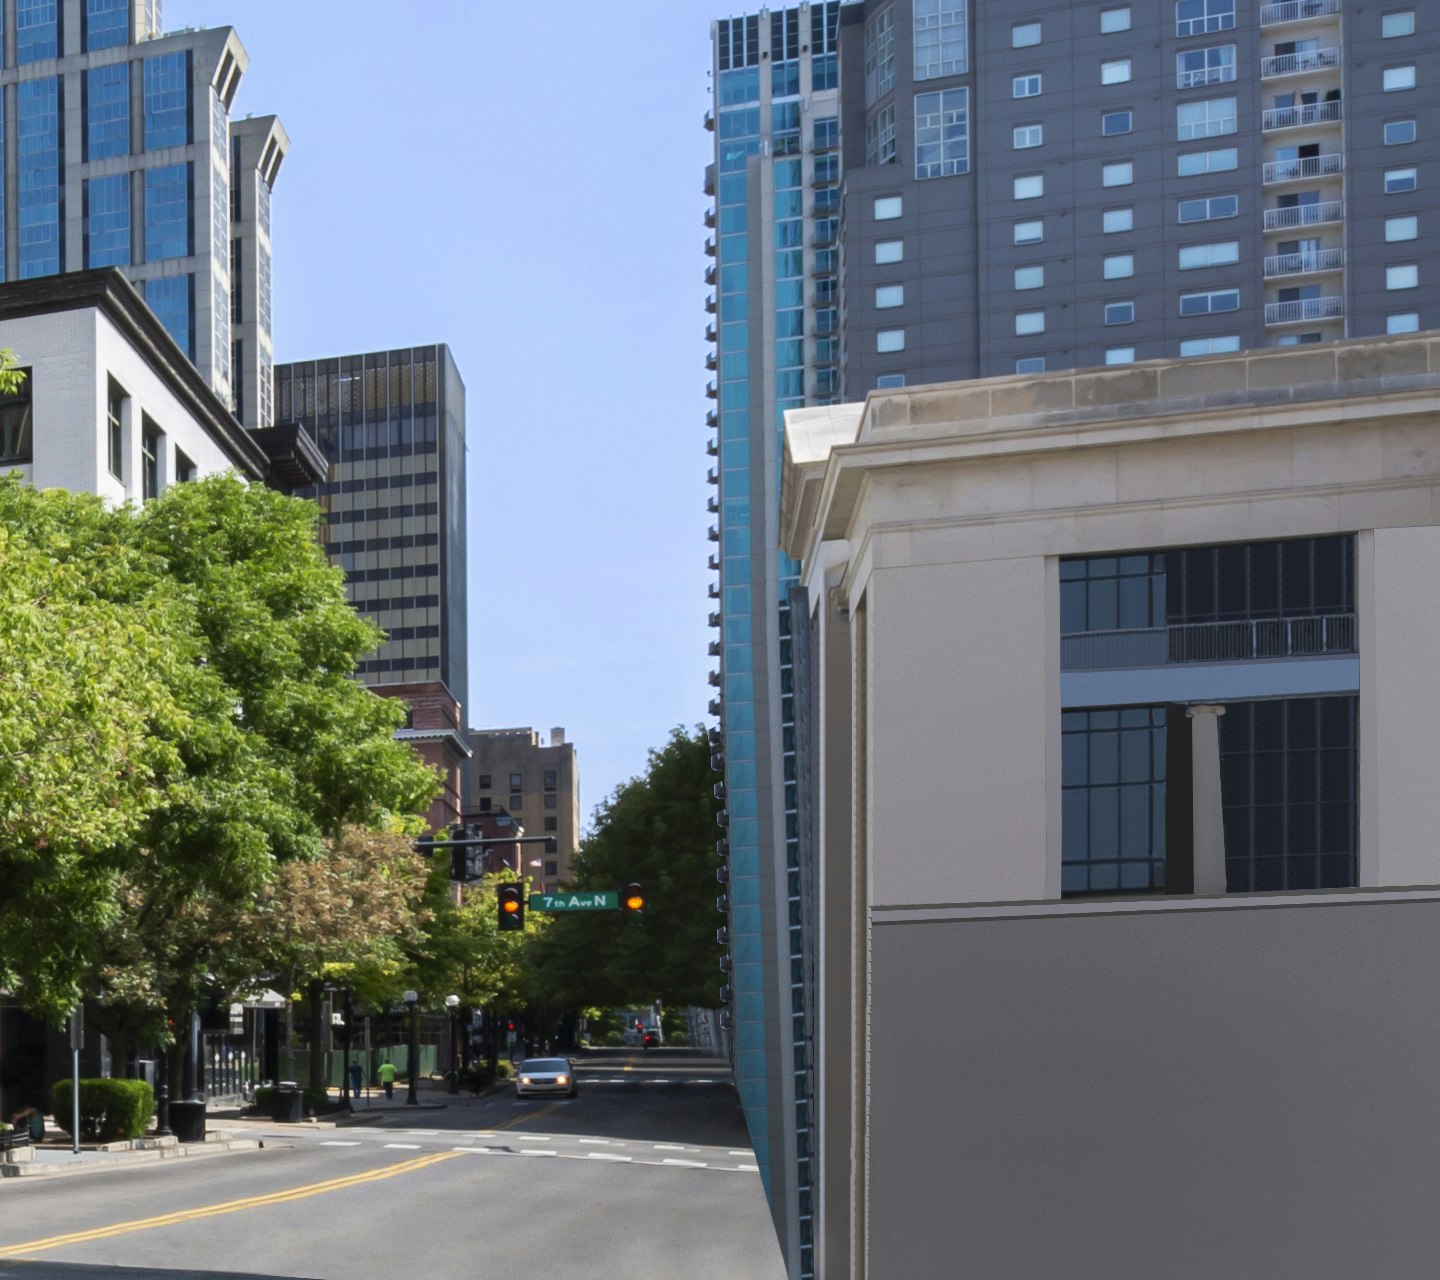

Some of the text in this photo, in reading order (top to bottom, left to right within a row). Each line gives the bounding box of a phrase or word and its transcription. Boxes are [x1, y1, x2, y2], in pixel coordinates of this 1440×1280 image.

[542, 894, 606, 908] 7th Ave N
